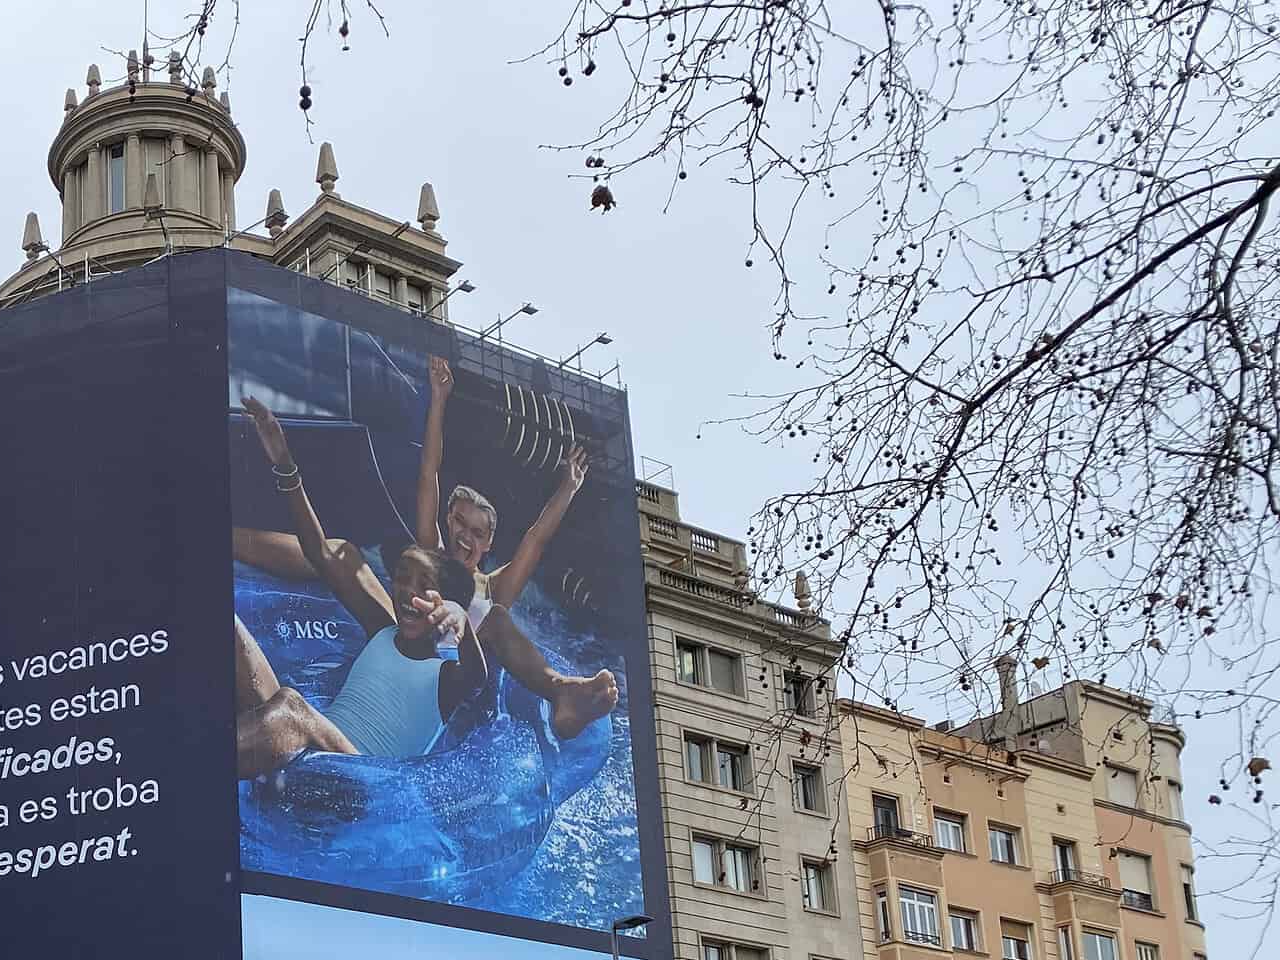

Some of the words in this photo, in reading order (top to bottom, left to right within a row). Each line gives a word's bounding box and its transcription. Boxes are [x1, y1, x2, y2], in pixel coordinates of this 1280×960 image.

[293, 620, 338, 640] MSC
[11, 629, 169, 681] vacances
[50, 683, 140, 722] estan
[19, 795, 57, 822] es
[66, 777, 159, 815] troba
